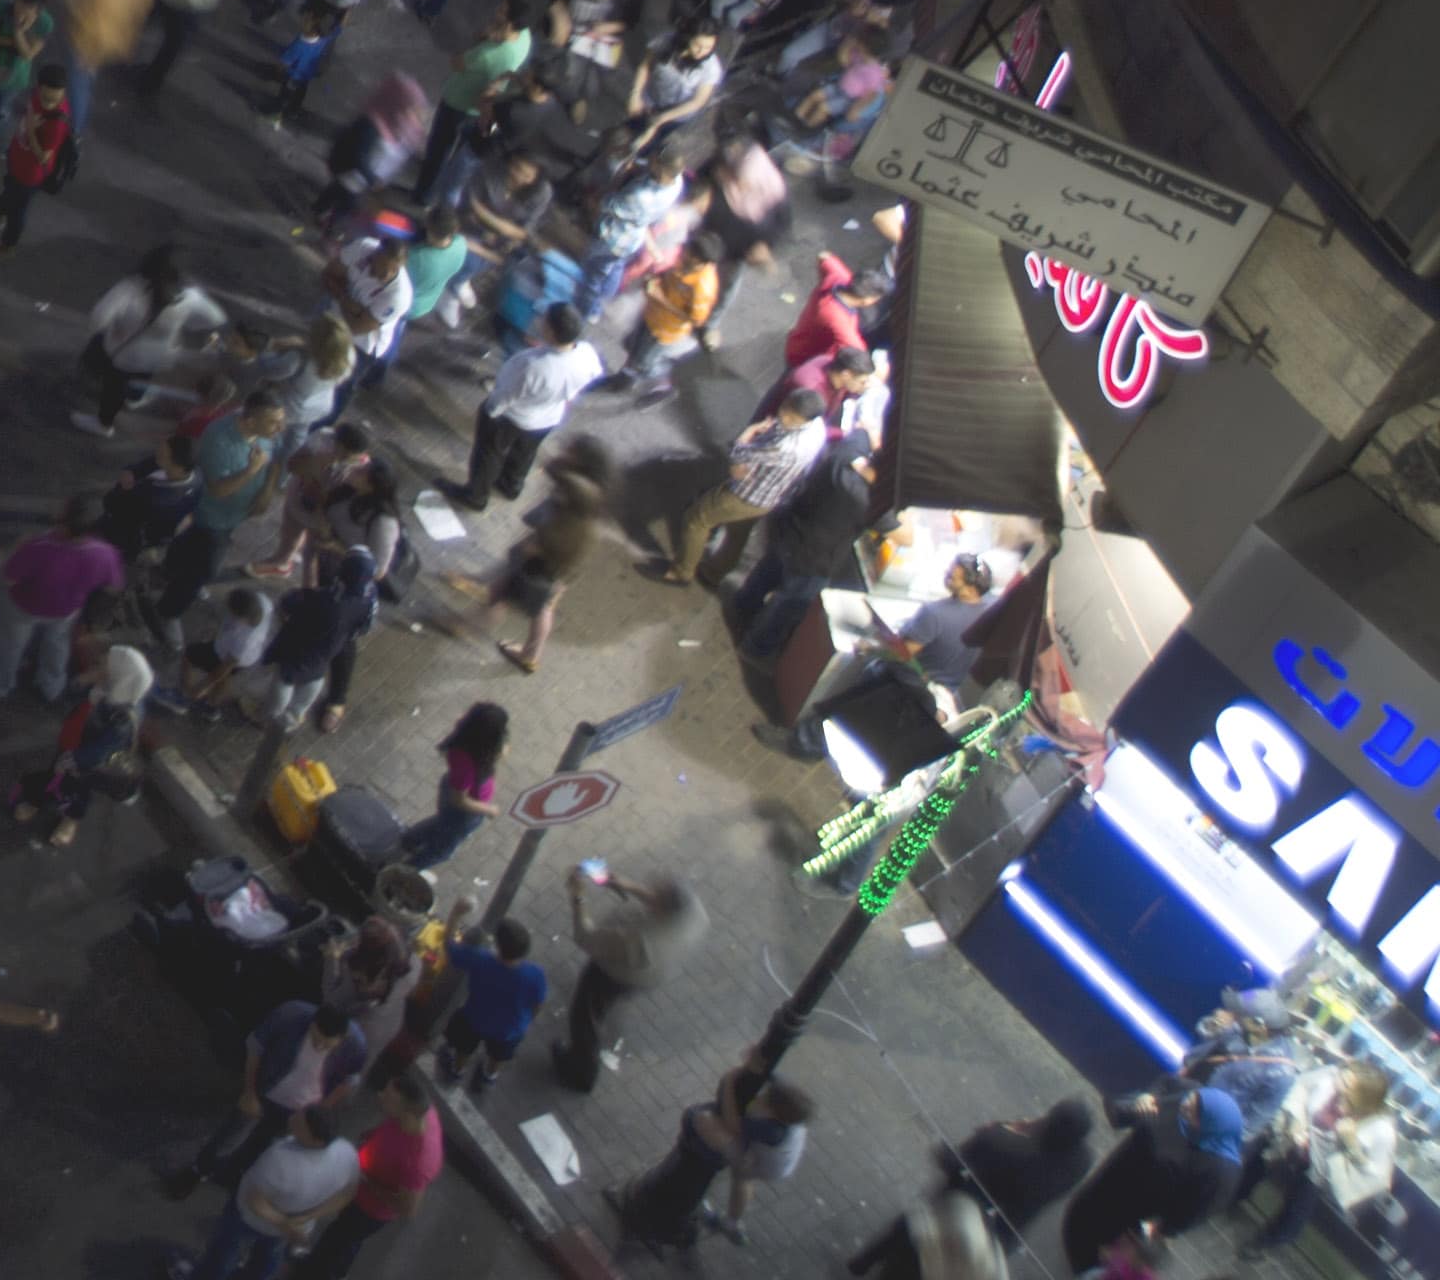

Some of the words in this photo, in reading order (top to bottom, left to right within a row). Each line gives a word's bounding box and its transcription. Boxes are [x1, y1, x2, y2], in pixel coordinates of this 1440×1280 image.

[876, 152, 983, 218] عثمان
[1060, 179, 1197, 245] المحامي
[991, 208, 1096, 270] شريف
[1099, 255, 1195, 307] منذر
